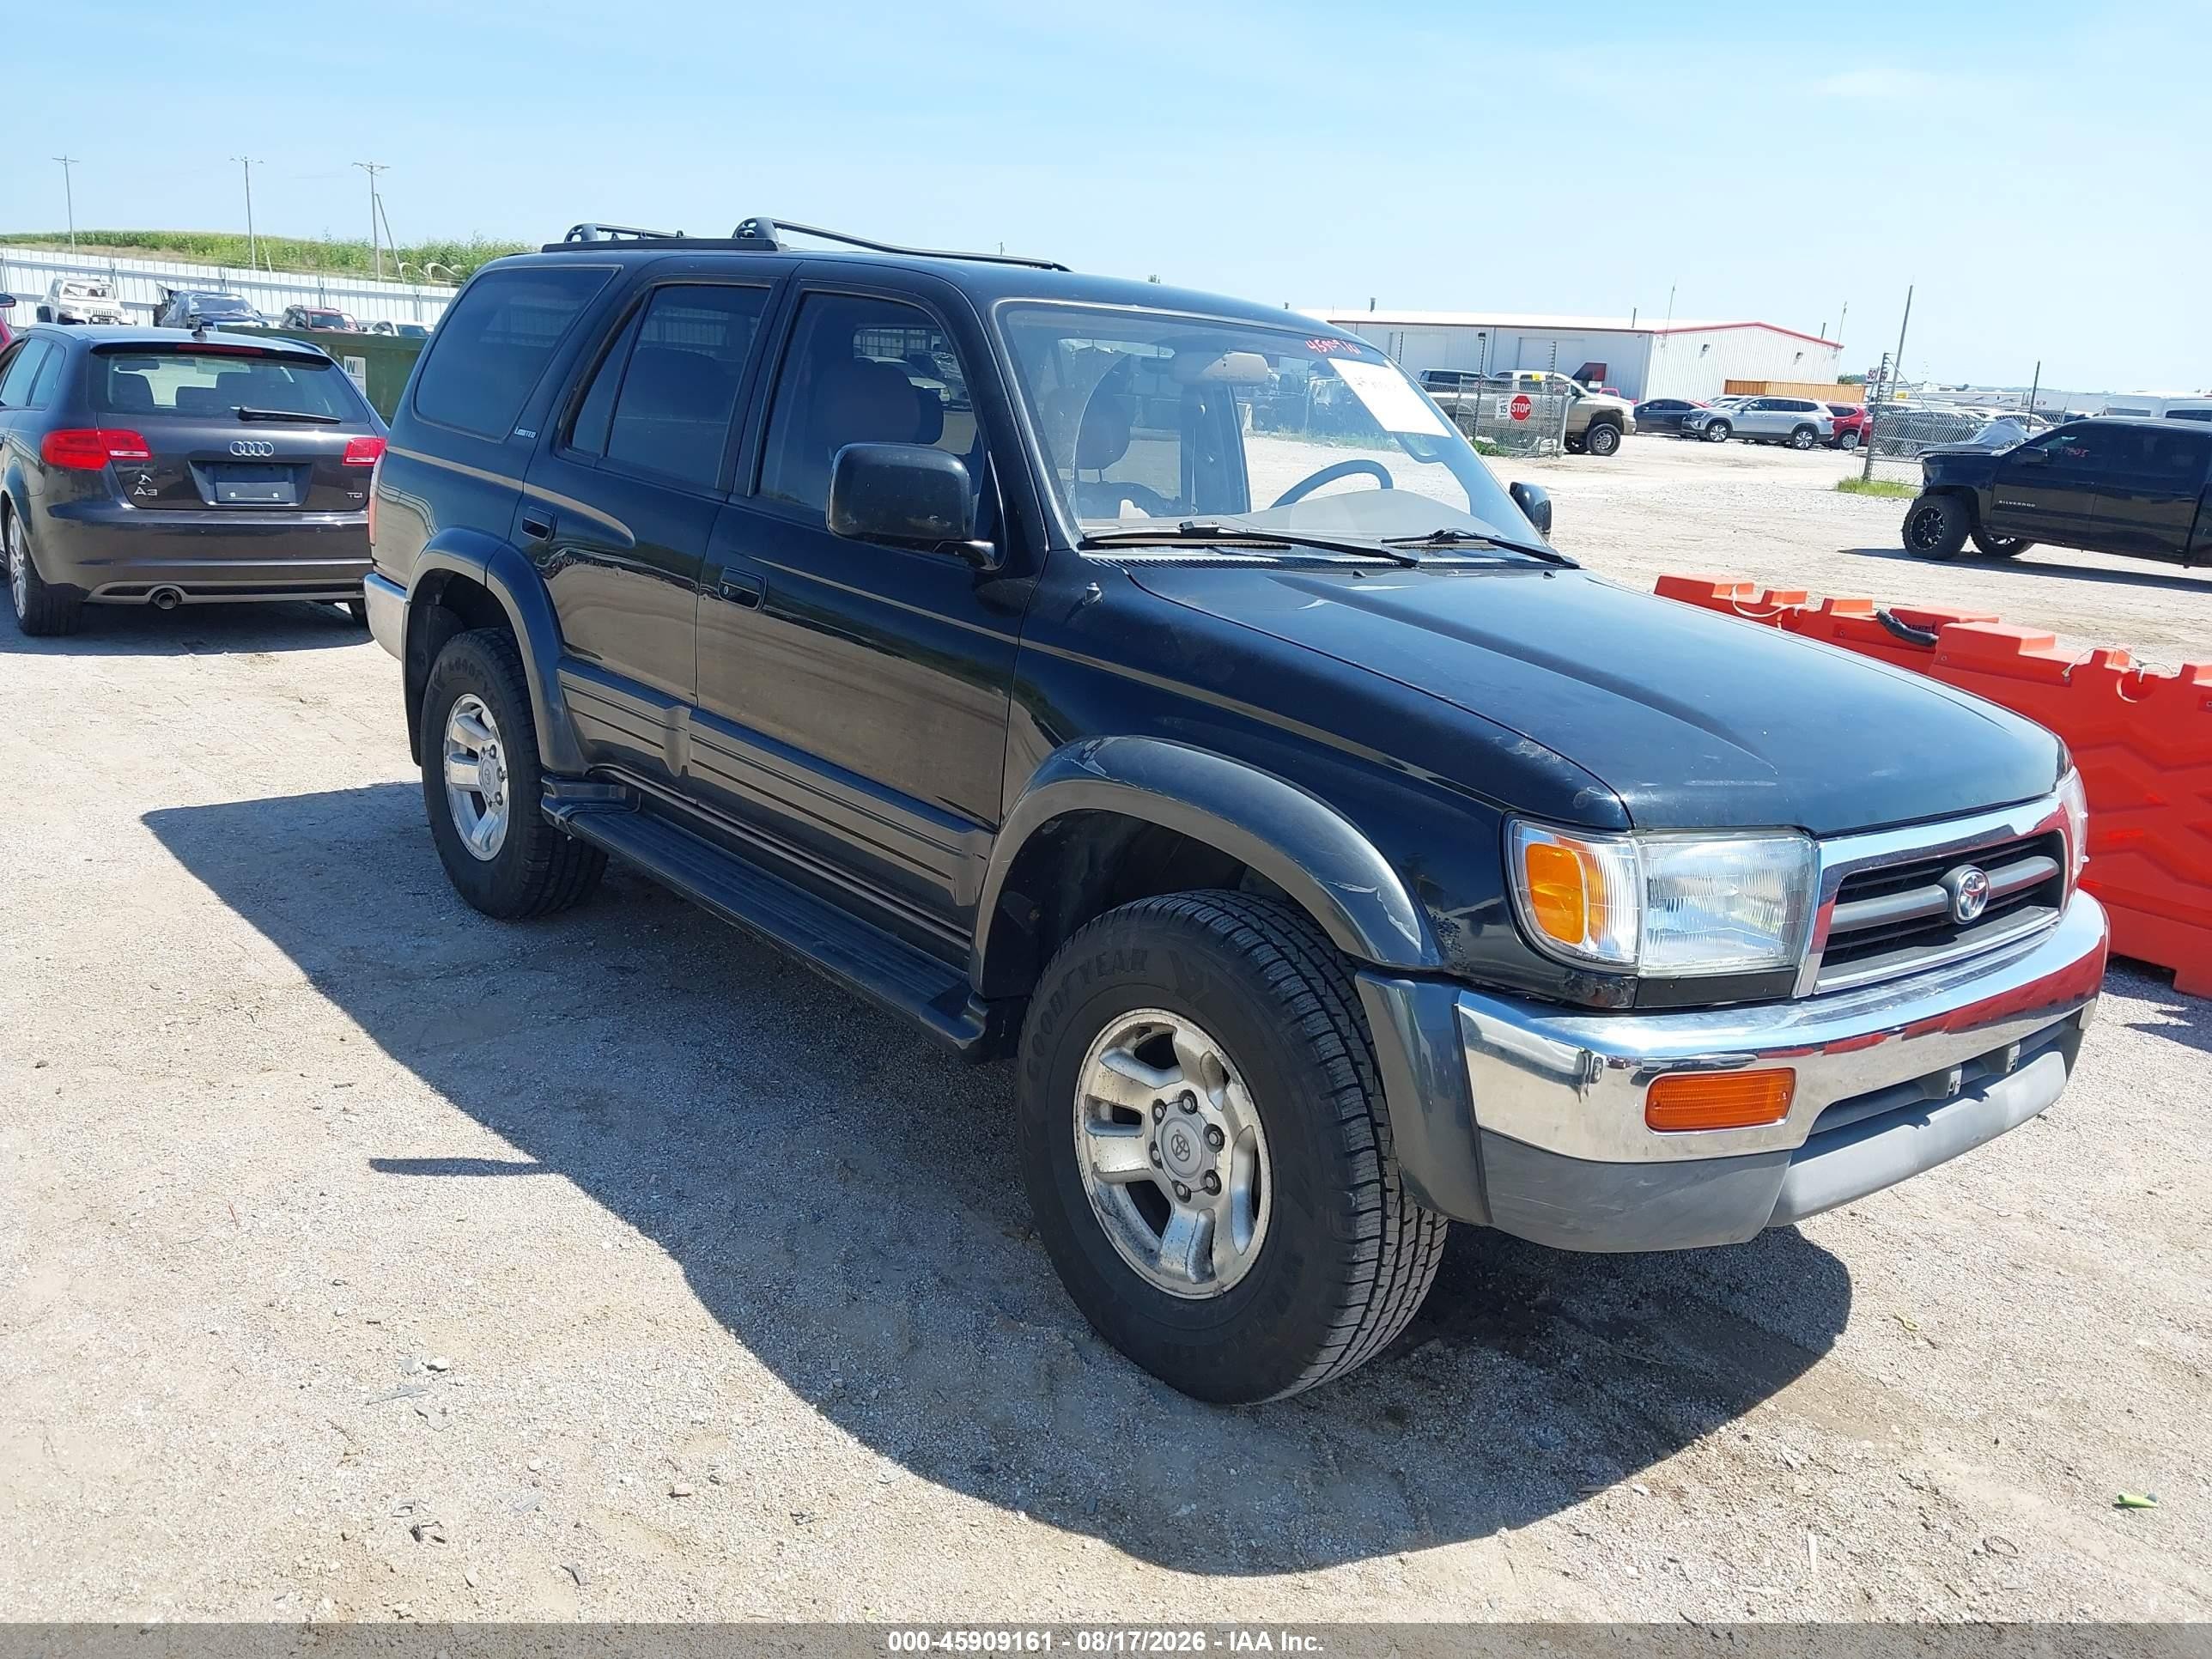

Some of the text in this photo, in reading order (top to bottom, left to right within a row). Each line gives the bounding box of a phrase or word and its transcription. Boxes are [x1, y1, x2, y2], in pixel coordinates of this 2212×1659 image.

[1499, 404, 1508, 413] 15
[1511, 403, 1530, 413] STOP
[134, 486, 158, 496] A3
